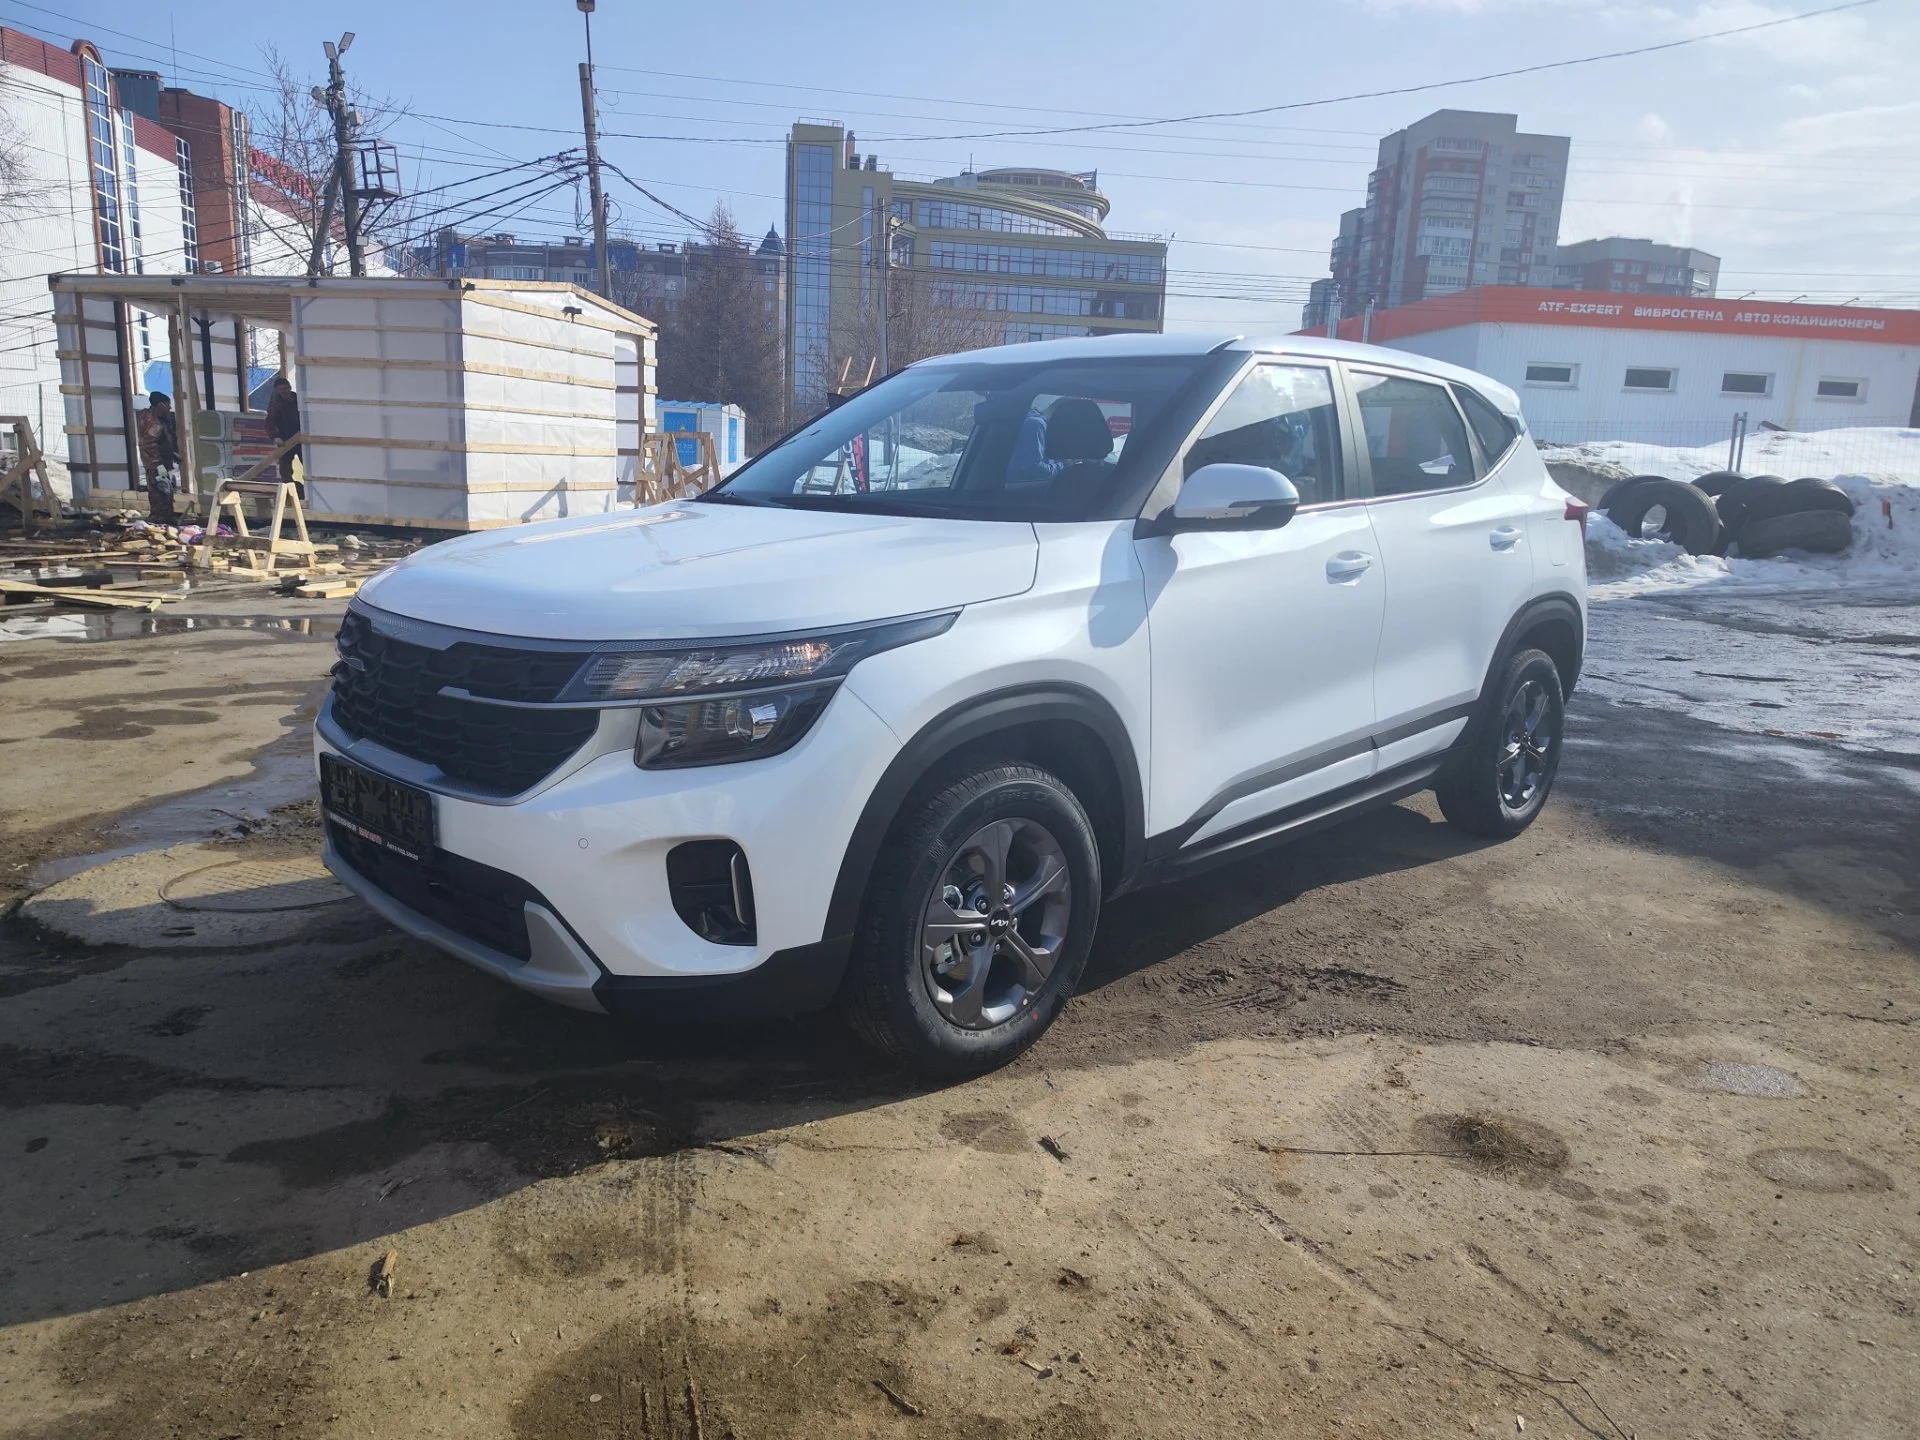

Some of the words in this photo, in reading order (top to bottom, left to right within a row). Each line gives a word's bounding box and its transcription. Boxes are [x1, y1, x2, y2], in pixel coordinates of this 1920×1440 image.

[1538, 302, 1623, 315] ATF-EXPERT
[1633, 307, 1724, 320] ВИБРОСТЕНД
[1734, 312, 1771, 323] АВТО
[1773, 314, 1885, 329] КОНДИЦИОНЕРЫ
